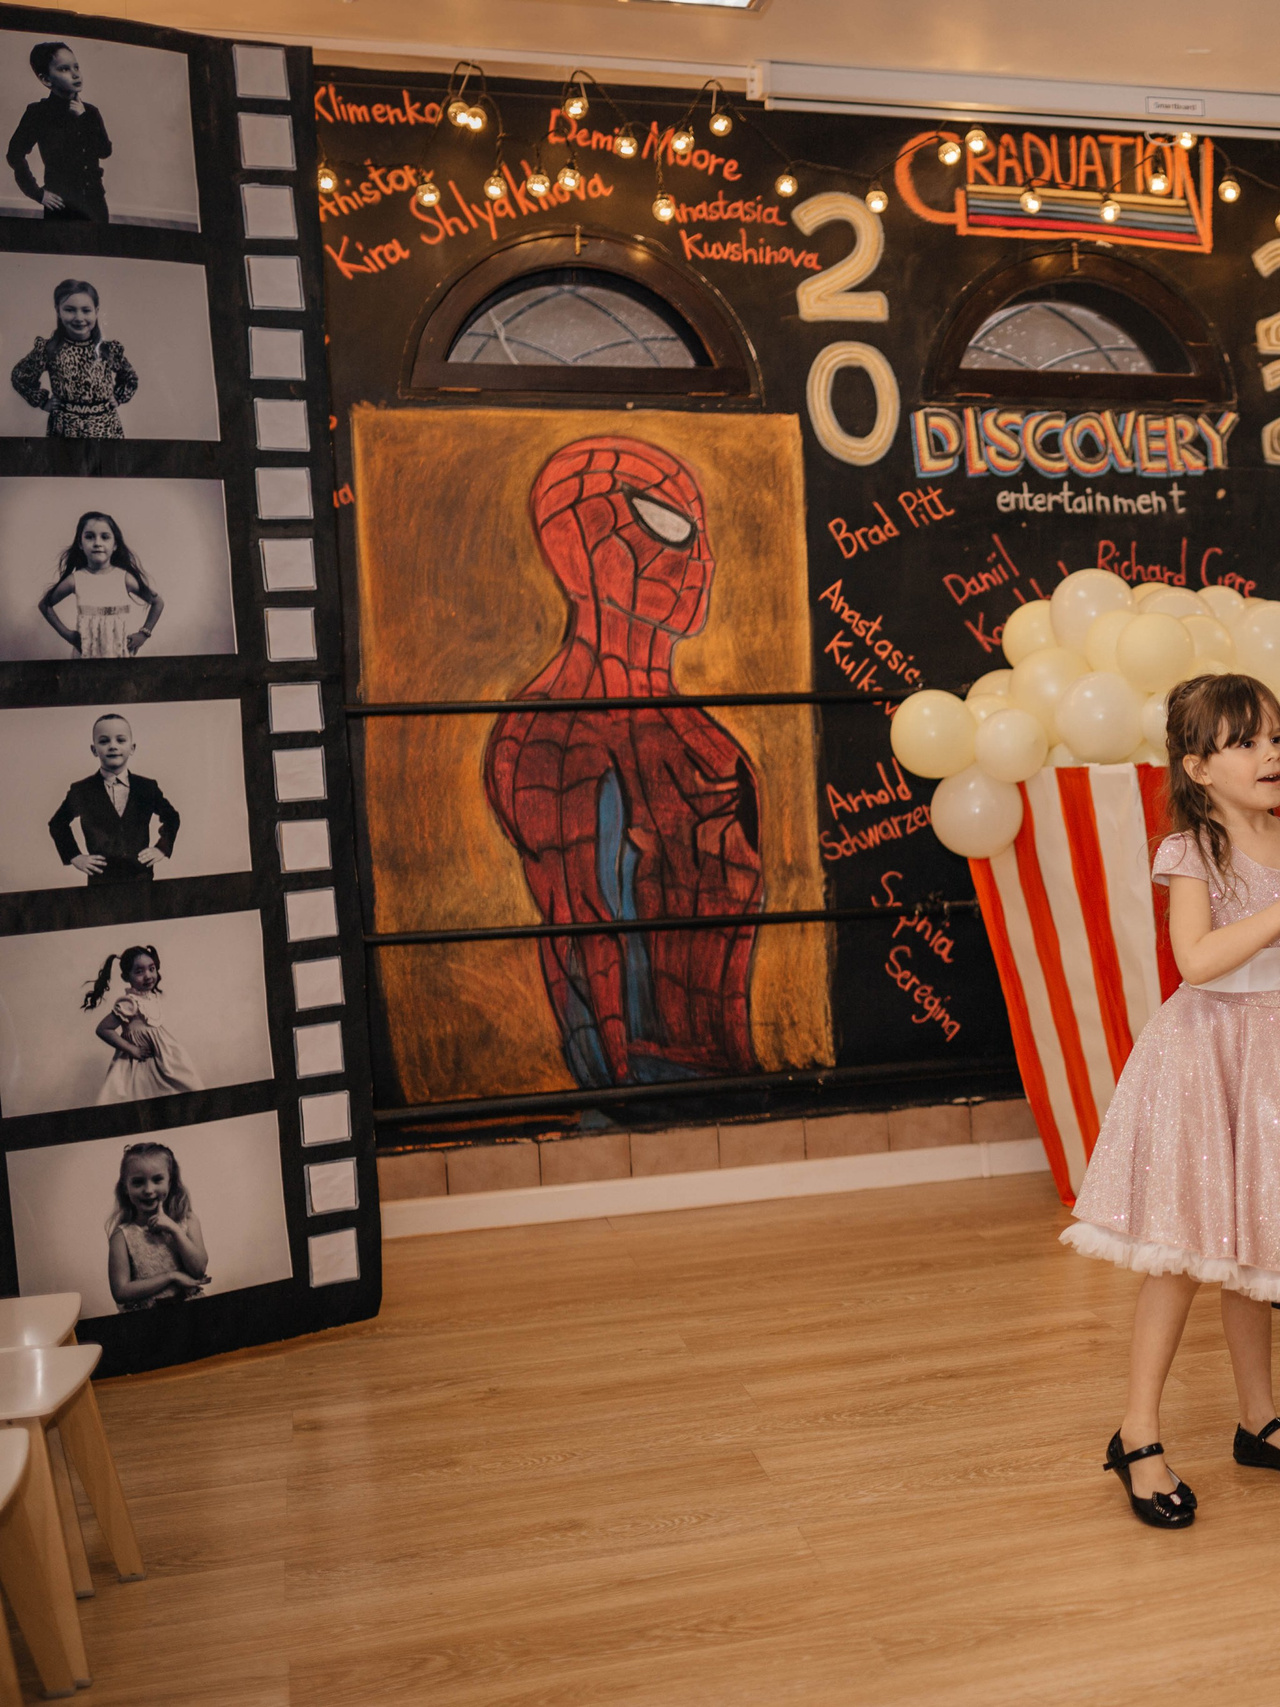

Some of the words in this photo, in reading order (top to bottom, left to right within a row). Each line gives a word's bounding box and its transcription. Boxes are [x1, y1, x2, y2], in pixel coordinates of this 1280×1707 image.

[314, 83, 444, 126] Klimenko
[894, 131, 1214, 253] GRADUATION
[324, 235, 410, 280] Kira
[910, 406, 1239, 478] DISCOVERY
[828, 501, 900, 559] Brad
[897, 486, 956, 528] Pitt
[996, 481, 1187, 515] entertainment
[1097, 537, 1187, 586] Richard
[826, 757, 913, 820] Arnold
